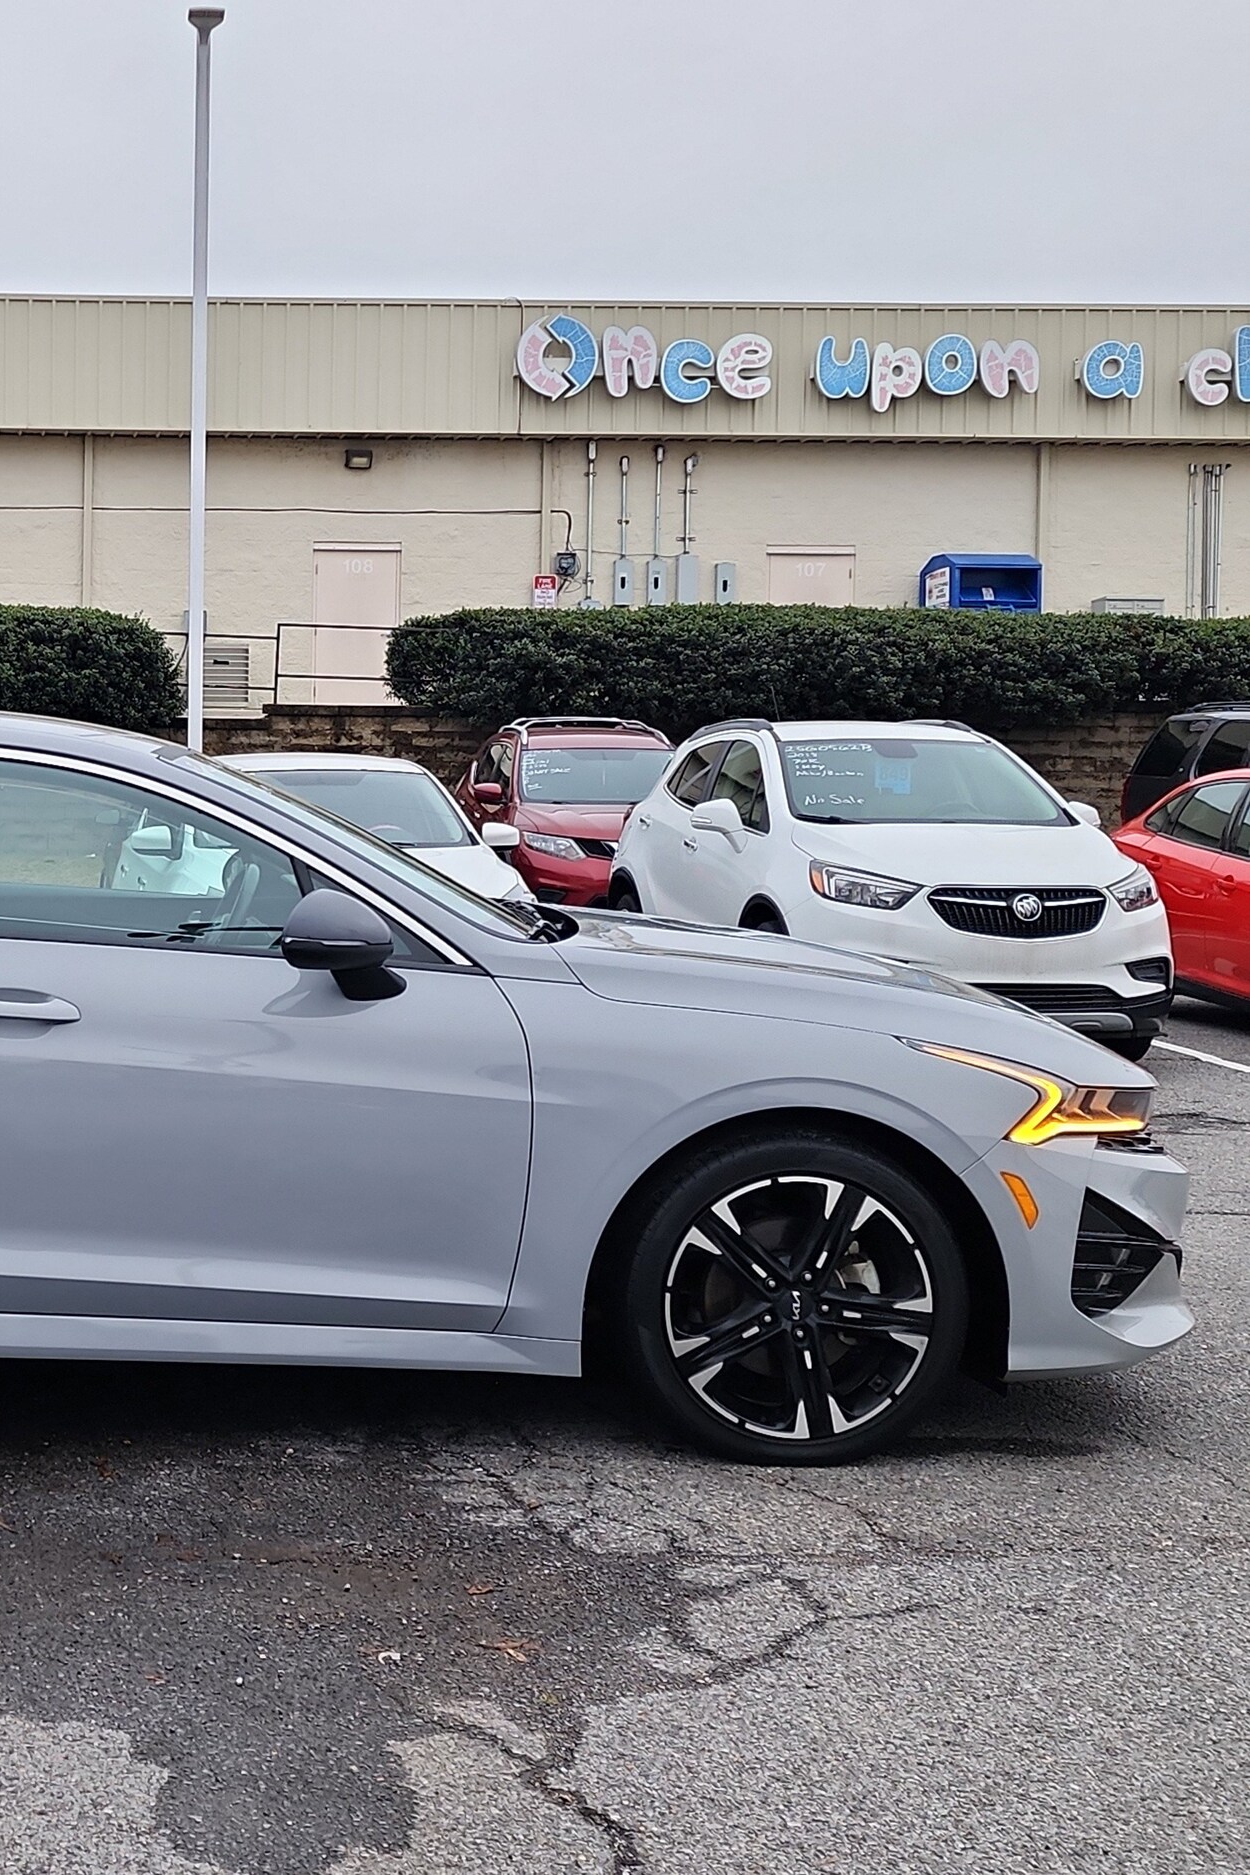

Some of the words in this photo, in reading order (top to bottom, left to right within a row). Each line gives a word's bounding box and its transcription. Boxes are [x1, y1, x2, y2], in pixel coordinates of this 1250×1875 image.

[516, 312, 773, 404] Once
[815, 333, 1040, 413] upon
[1081, 339, 1144, 400] a
[343, 558, 374, 574] 108
[795, 562, 827, 577] 107
[804, 794, 825, 806] No
[829, 793, 867, 806] Sale
